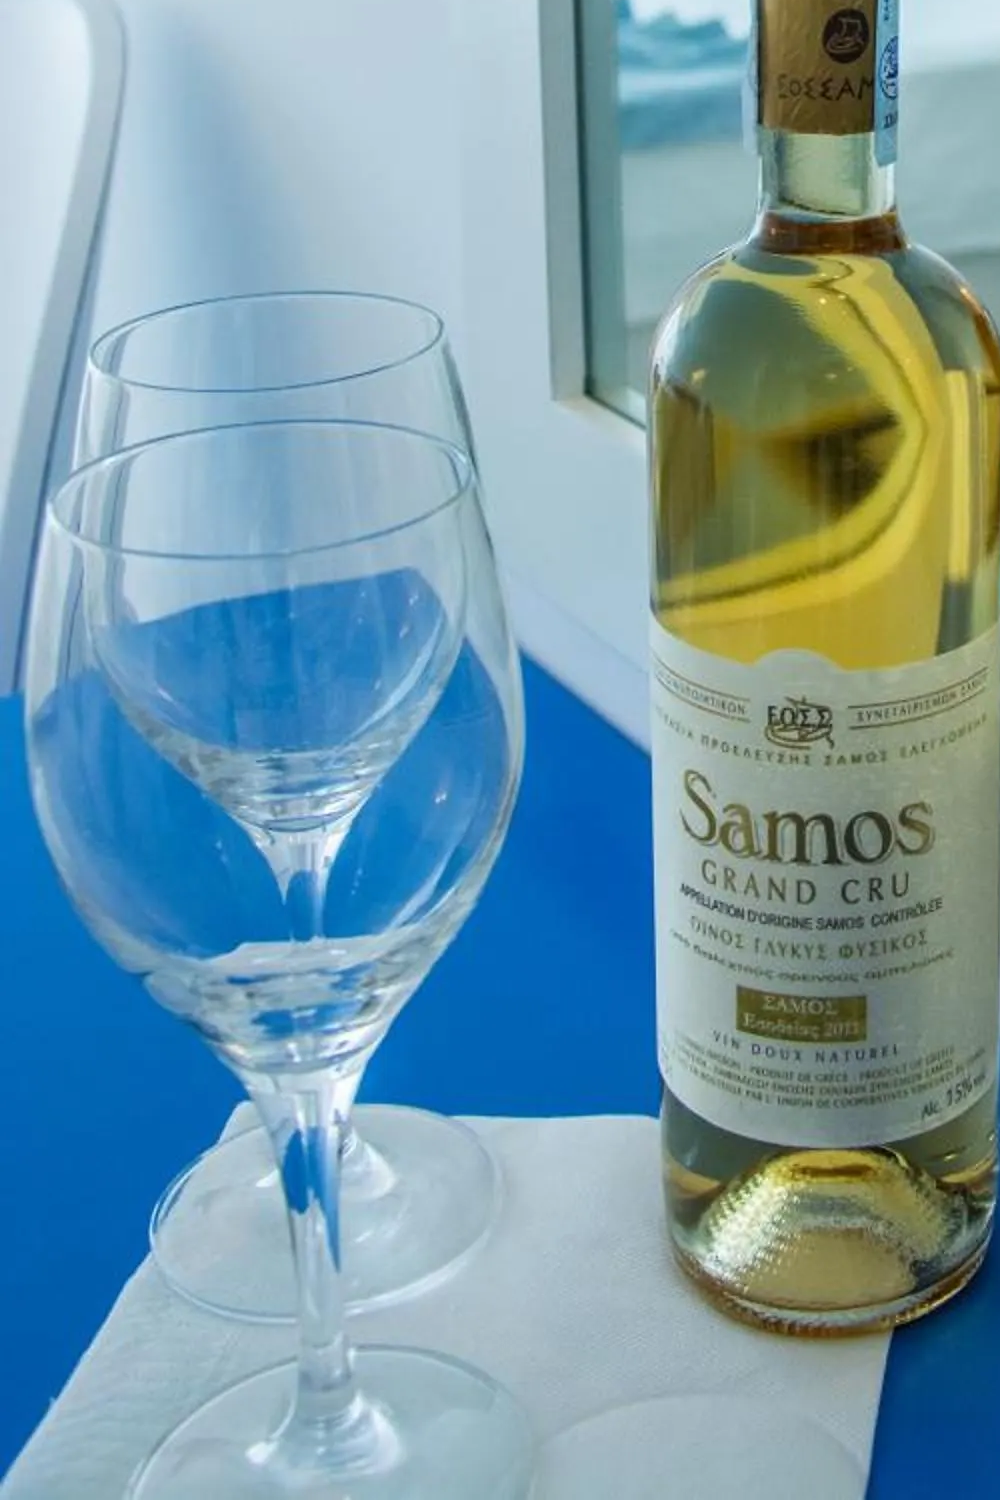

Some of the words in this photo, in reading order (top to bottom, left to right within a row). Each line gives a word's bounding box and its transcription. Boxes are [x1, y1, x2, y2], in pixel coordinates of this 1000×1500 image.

[679, 769, 935, 866] Samos
[701, 859, 816, 905] GRAND
[841, 873, 910, 905] CRU
[816, 916, 864, 931] SAMOS
[838, 928, 929, 960] ΦΥΣΙΚΟΣ
[713, 1030, 741, 1050] VIN
[751, 1043, 803, 1062] DOUX
